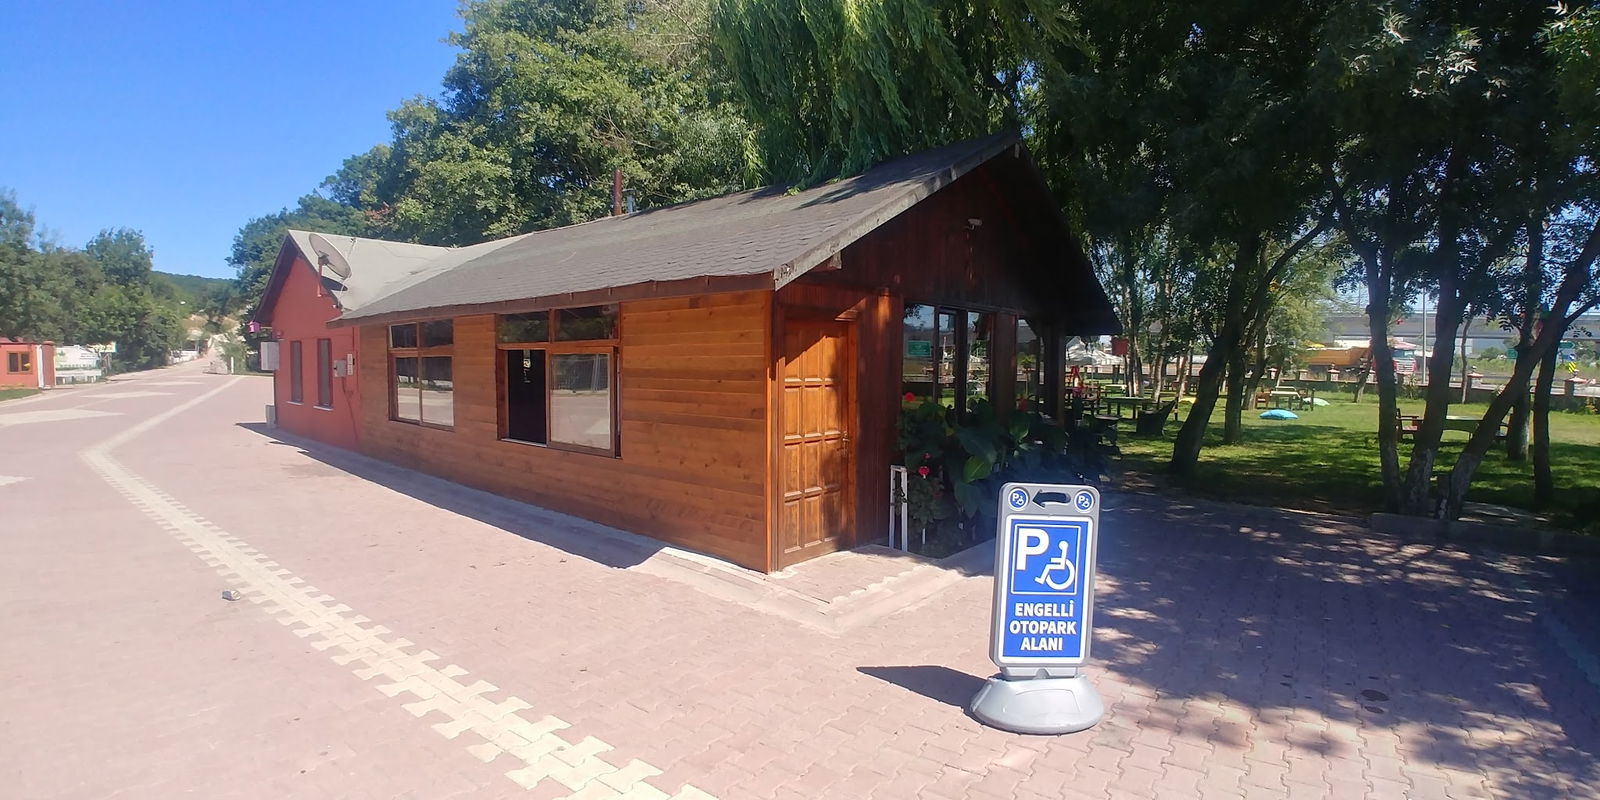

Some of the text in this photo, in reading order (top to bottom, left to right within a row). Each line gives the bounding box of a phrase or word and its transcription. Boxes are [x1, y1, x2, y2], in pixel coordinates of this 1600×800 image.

[1012, 493, 1019, 501] P
[1078, 495, 1085, 504] P
[1016, 528, 1050, 570] P
[1014, 599, 1074, 617] ENGELLİ
[1009, 620, 1077, 634] OTOPARK
[1020, 637, 1063, 651] ALANI
